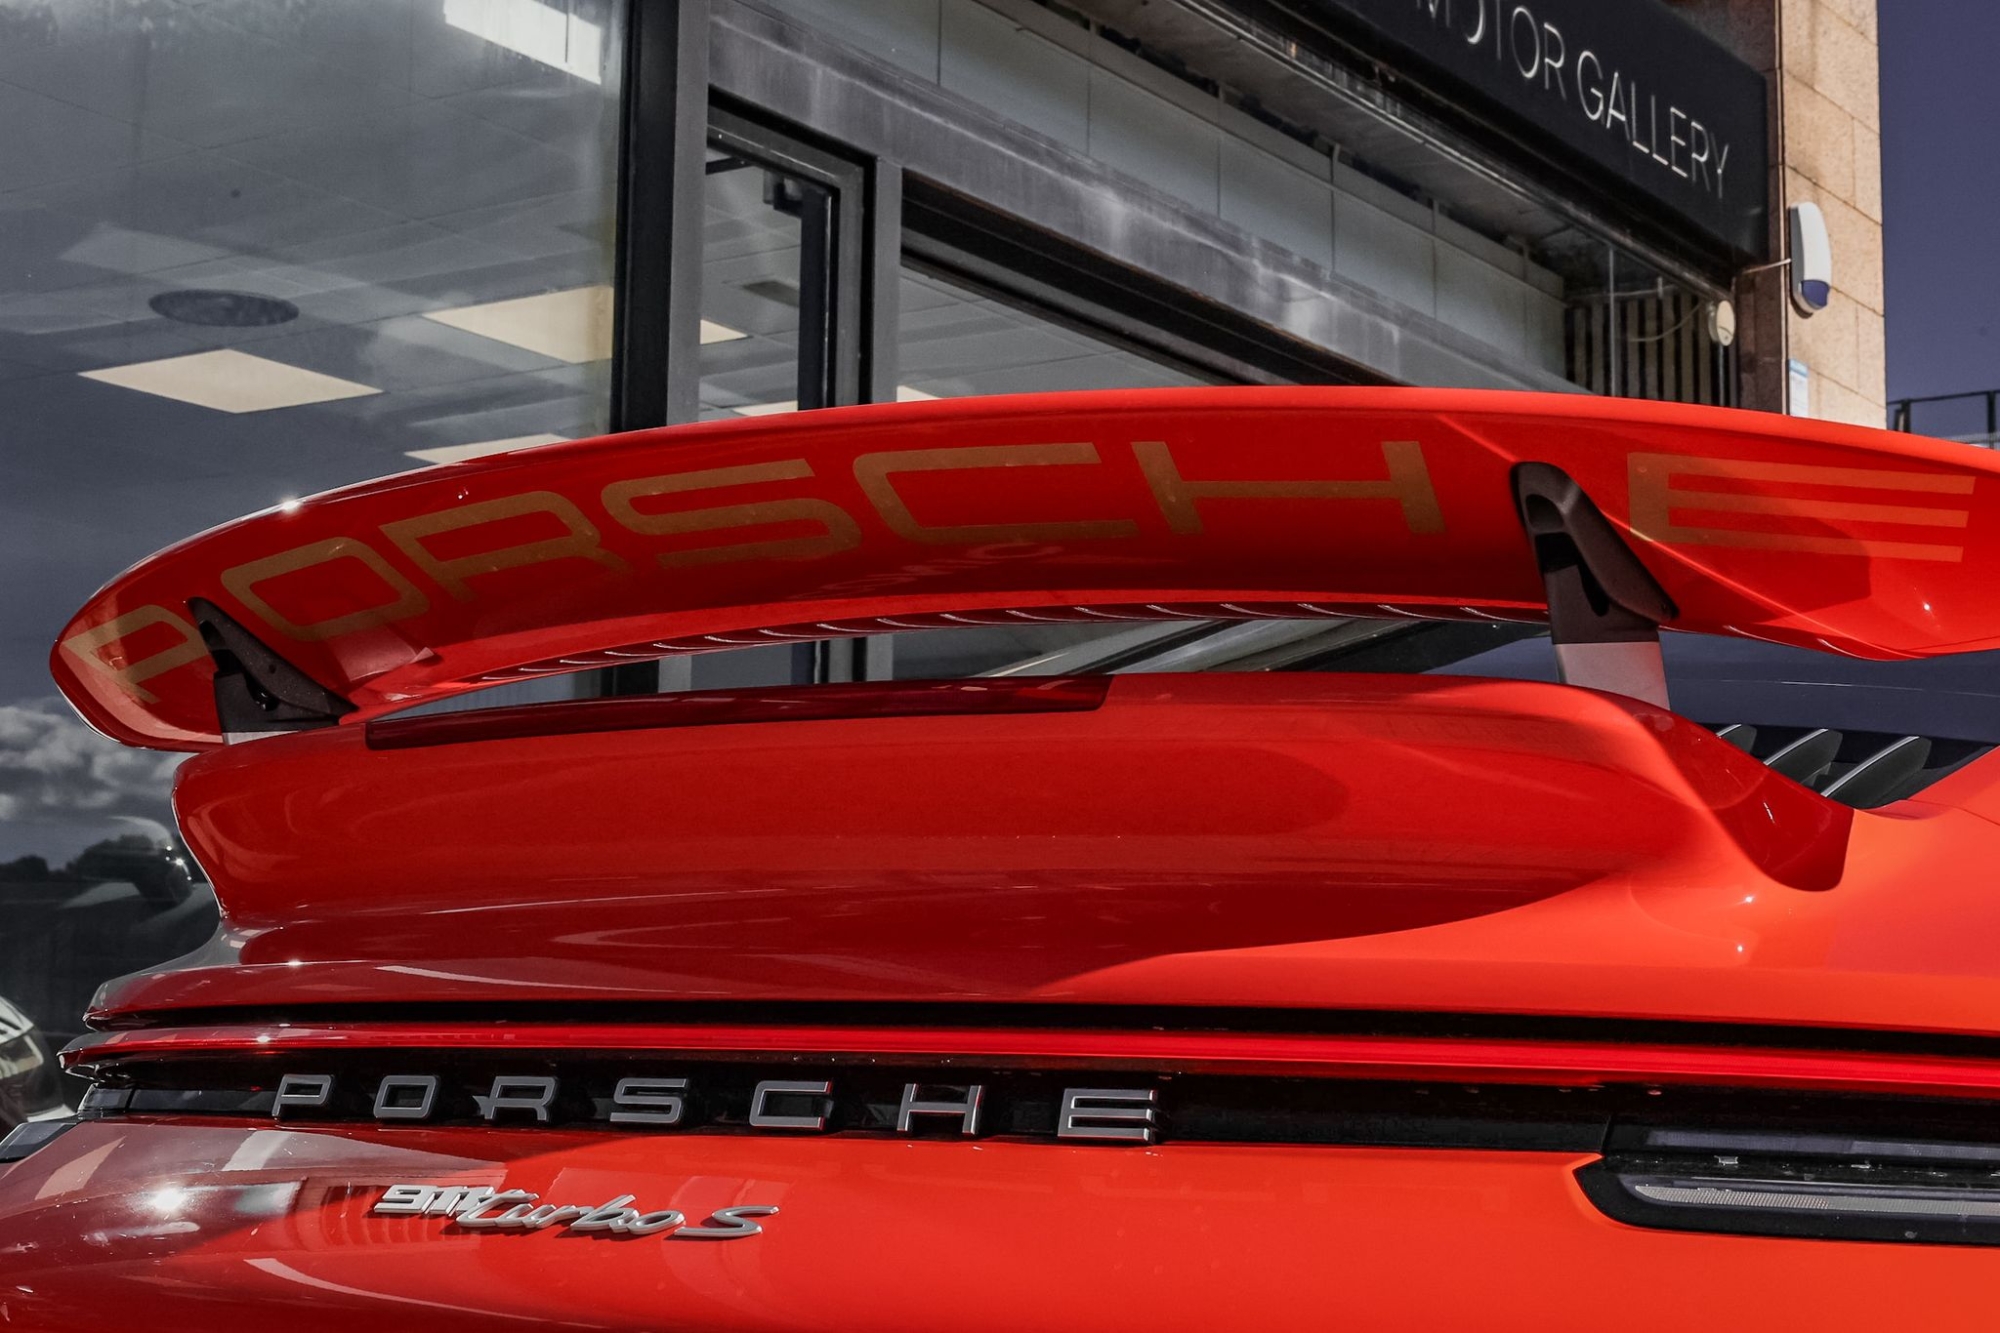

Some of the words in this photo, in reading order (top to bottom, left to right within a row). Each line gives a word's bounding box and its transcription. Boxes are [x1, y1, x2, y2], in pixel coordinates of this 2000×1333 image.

[1415, 0, 1567, 98] OTOR
[1577, 50, 1729, 199] GALLERY
[60, 440, 1977, 704] PORSCHE
[271, 1073, 1158, 1143] PORSCHE
[374, 1184, 496, 1217] 911
[456, 1189, 686, 1236] turbo
[674, 1204, 780, 1238] S
